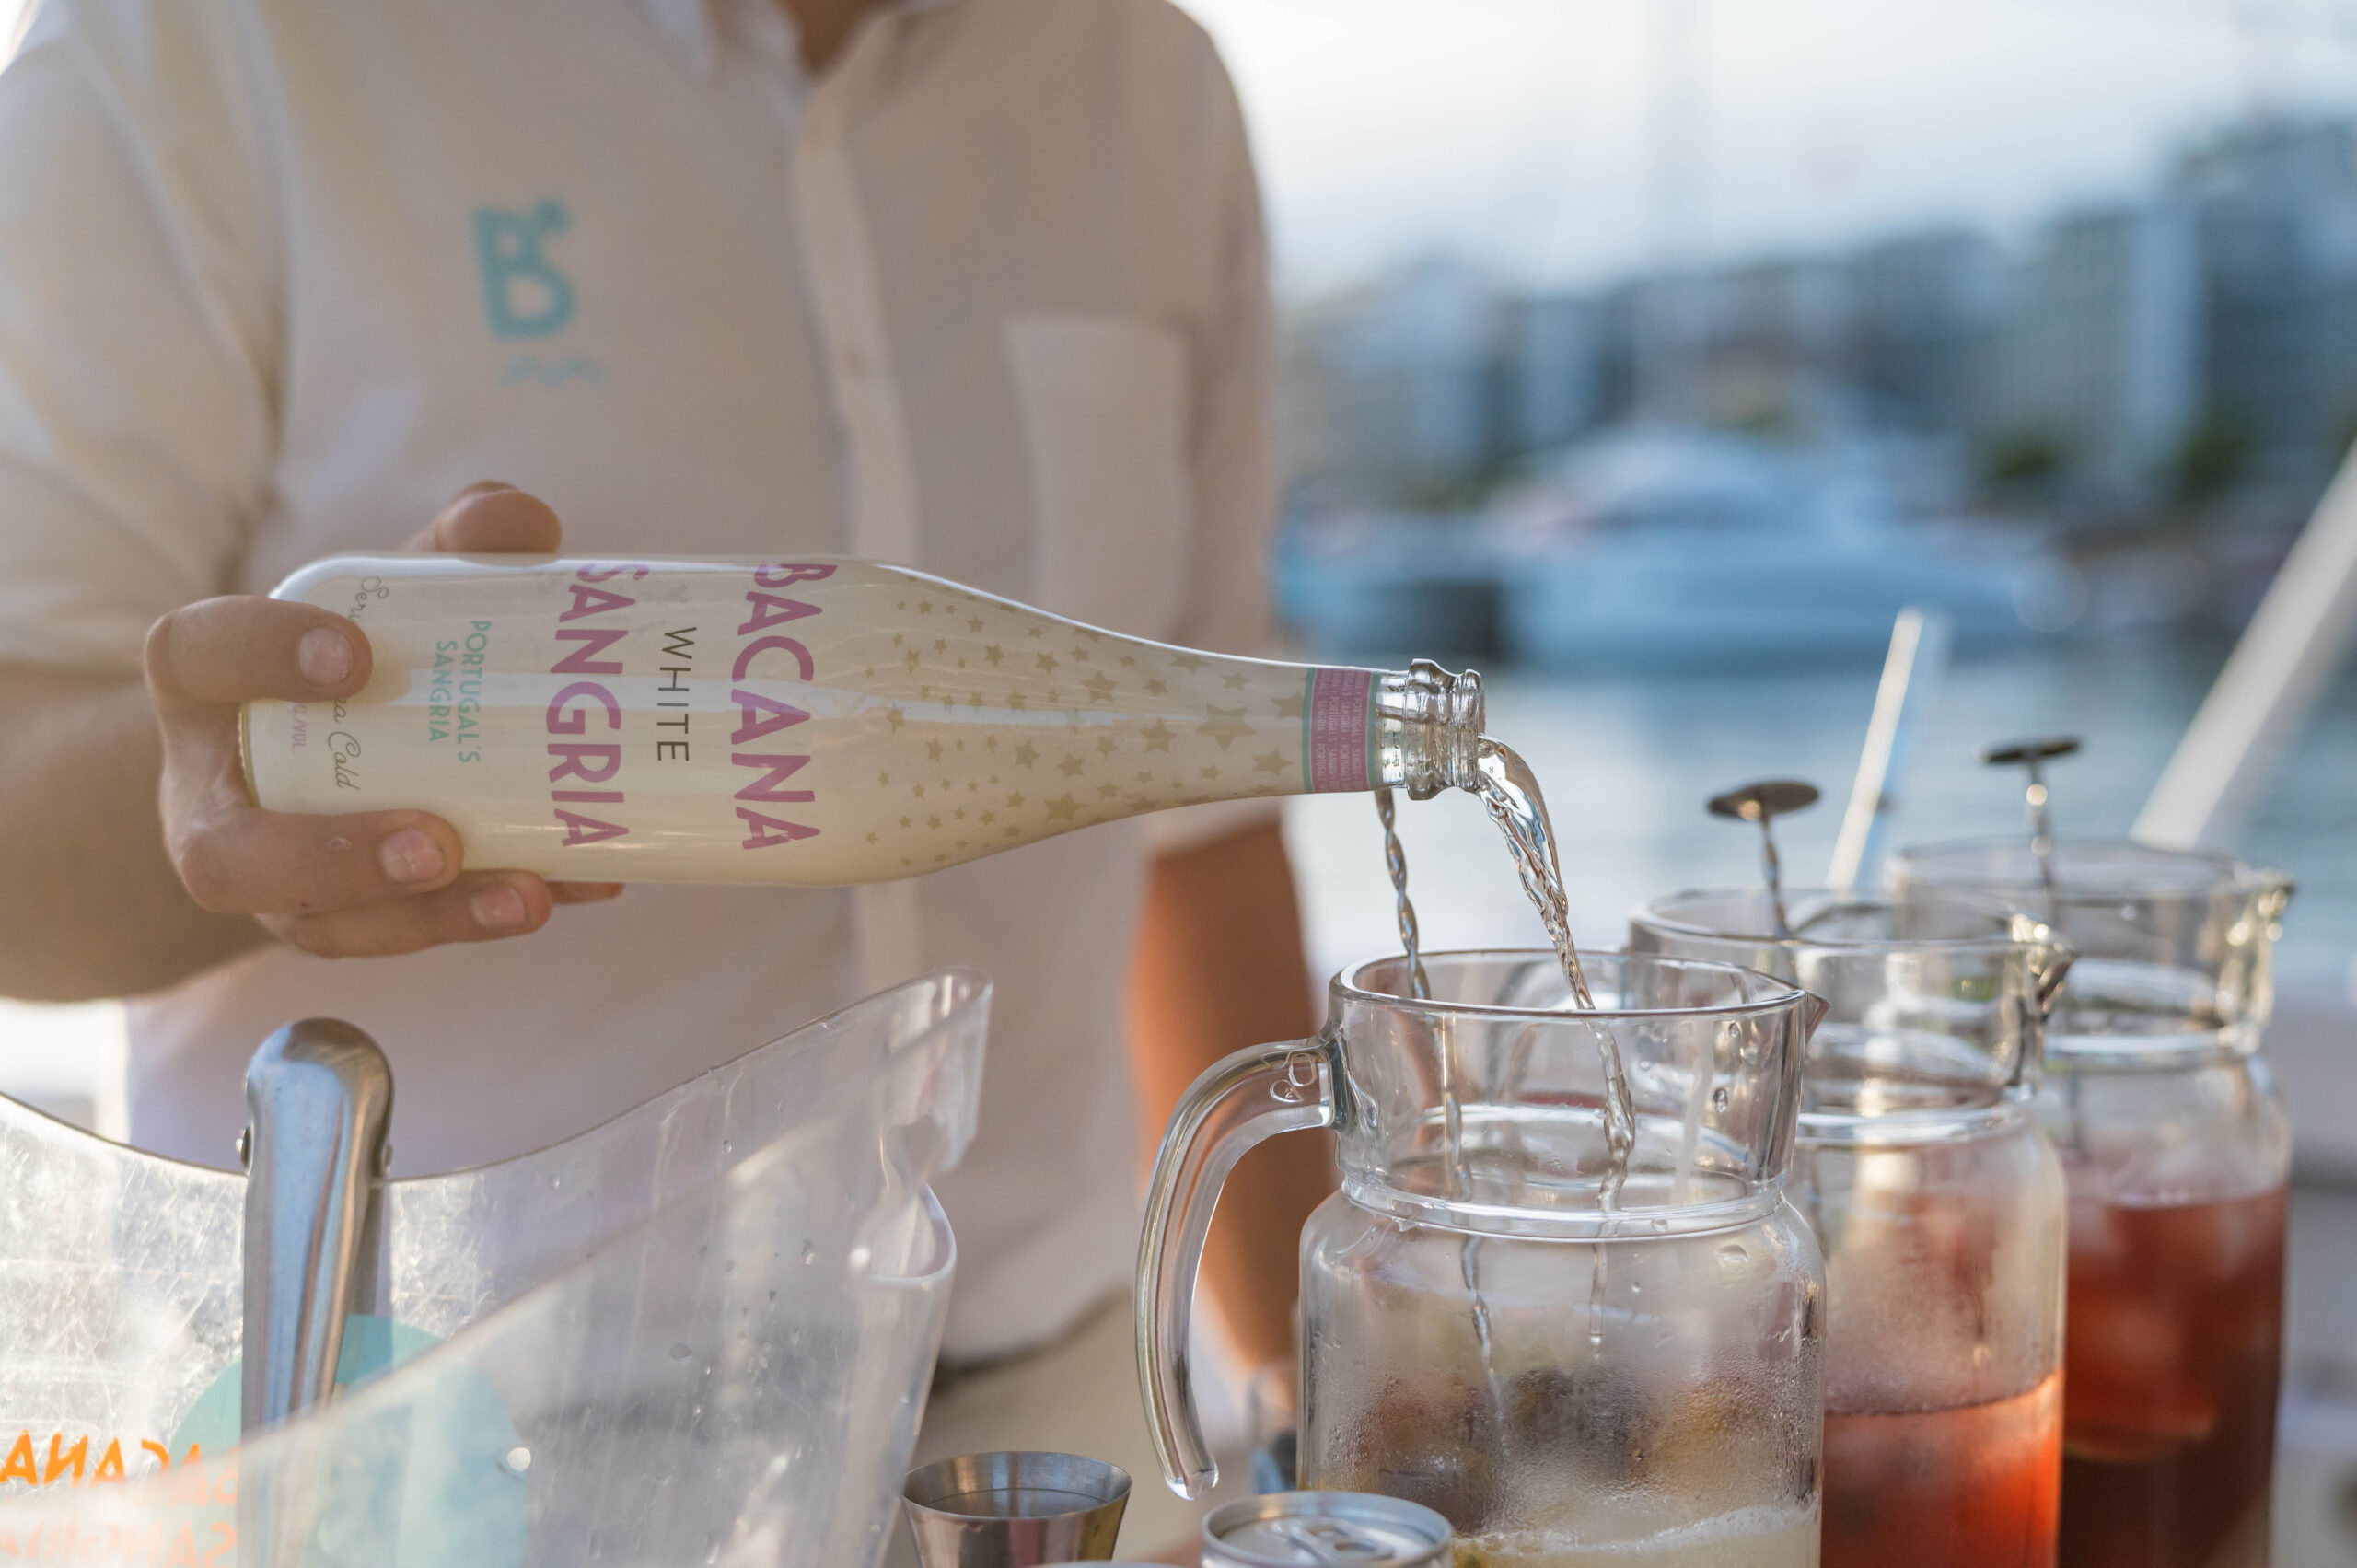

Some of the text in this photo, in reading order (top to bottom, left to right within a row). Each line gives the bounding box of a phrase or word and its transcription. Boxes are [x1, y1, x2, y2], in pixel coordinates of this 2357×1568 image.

[428, 639, 458, 742] SANGRIA
[458, 620, 493, 763] PORTUGAL'S
[546, 563, 650, 846] SANGRIA
[656, 626, 697, 761] WHITE
[731, 563, 837, 850] BACANA
[327, 731, 362, 791] Cold
